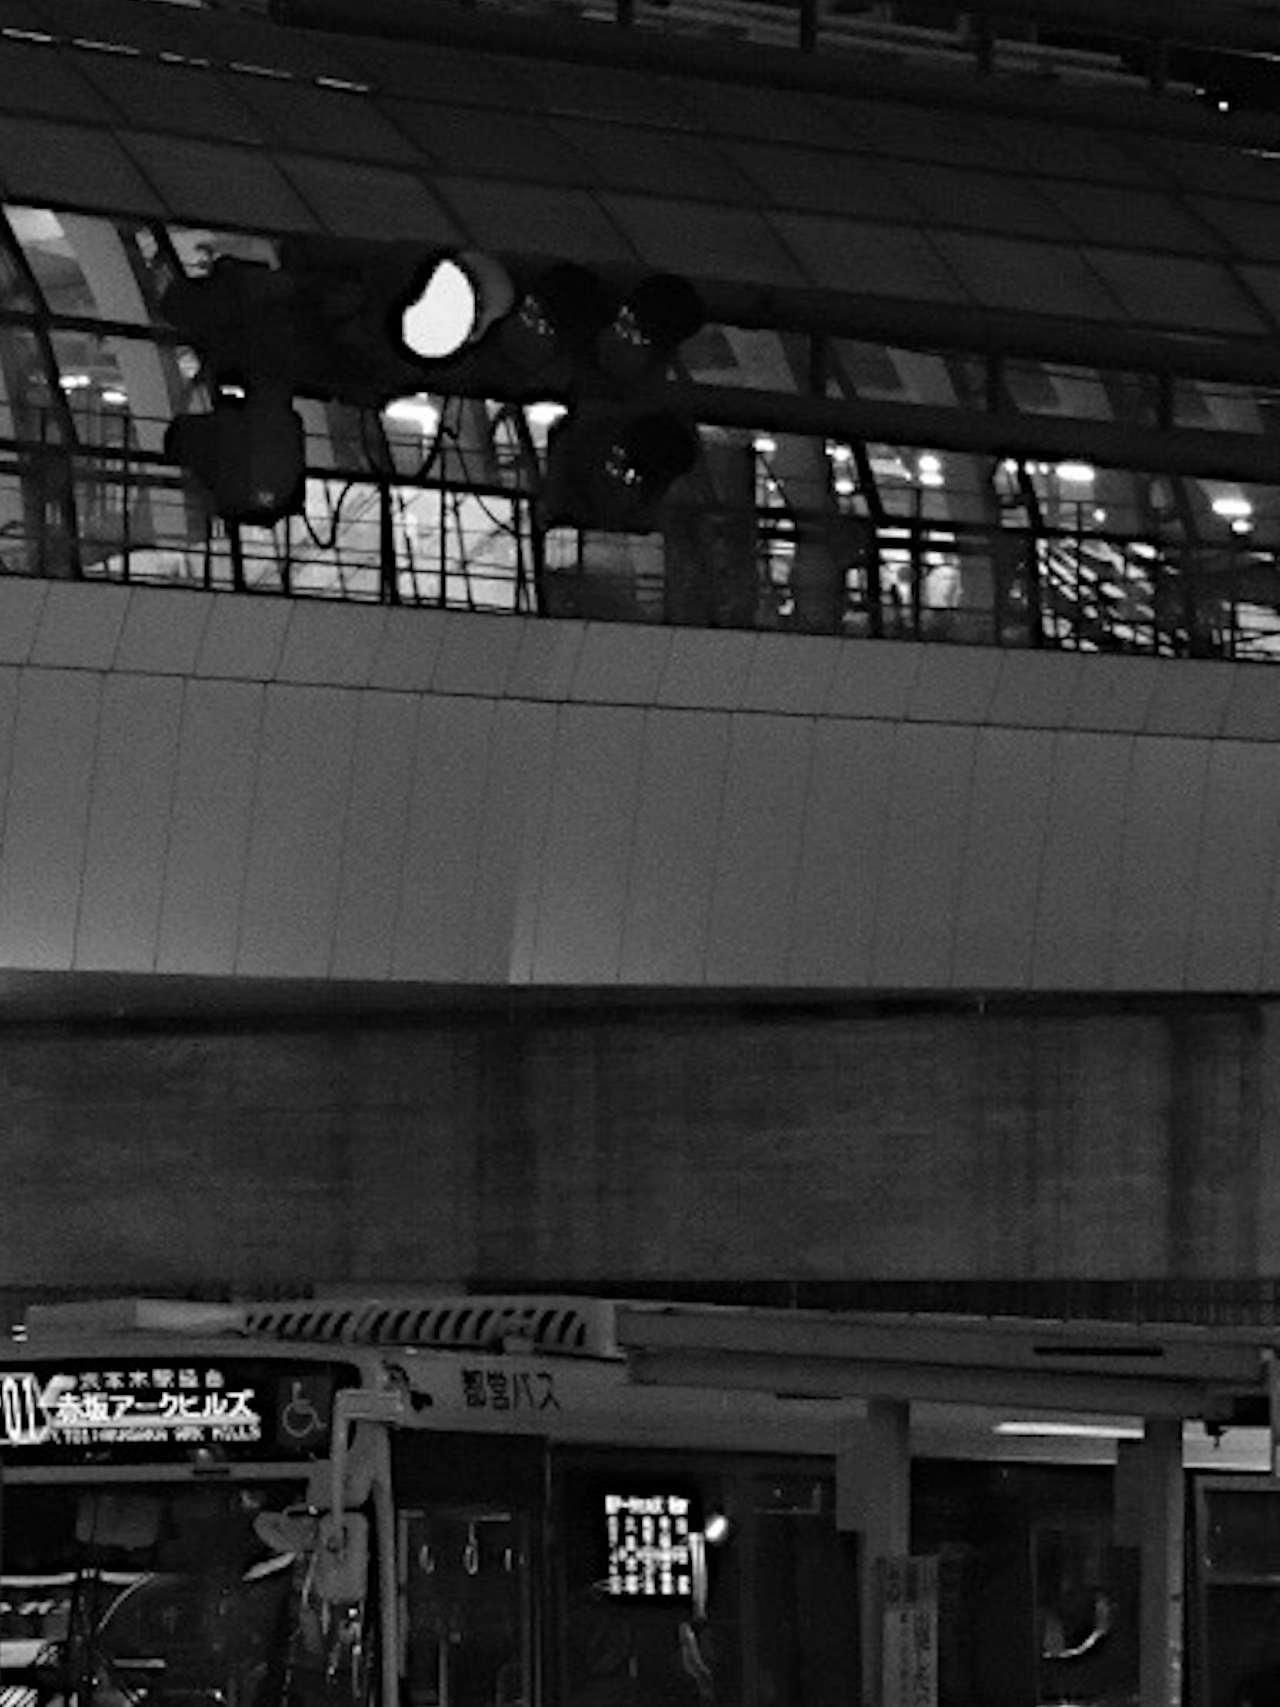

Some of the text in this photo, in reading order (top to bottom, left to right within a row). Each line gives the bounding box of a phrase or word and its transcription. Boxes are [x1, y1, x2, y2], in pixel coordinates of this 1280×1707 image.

[56, 1390, 256, 1423] 赤坂アークヒルズ
[462, 1369, 562, 1411] 都営バス
